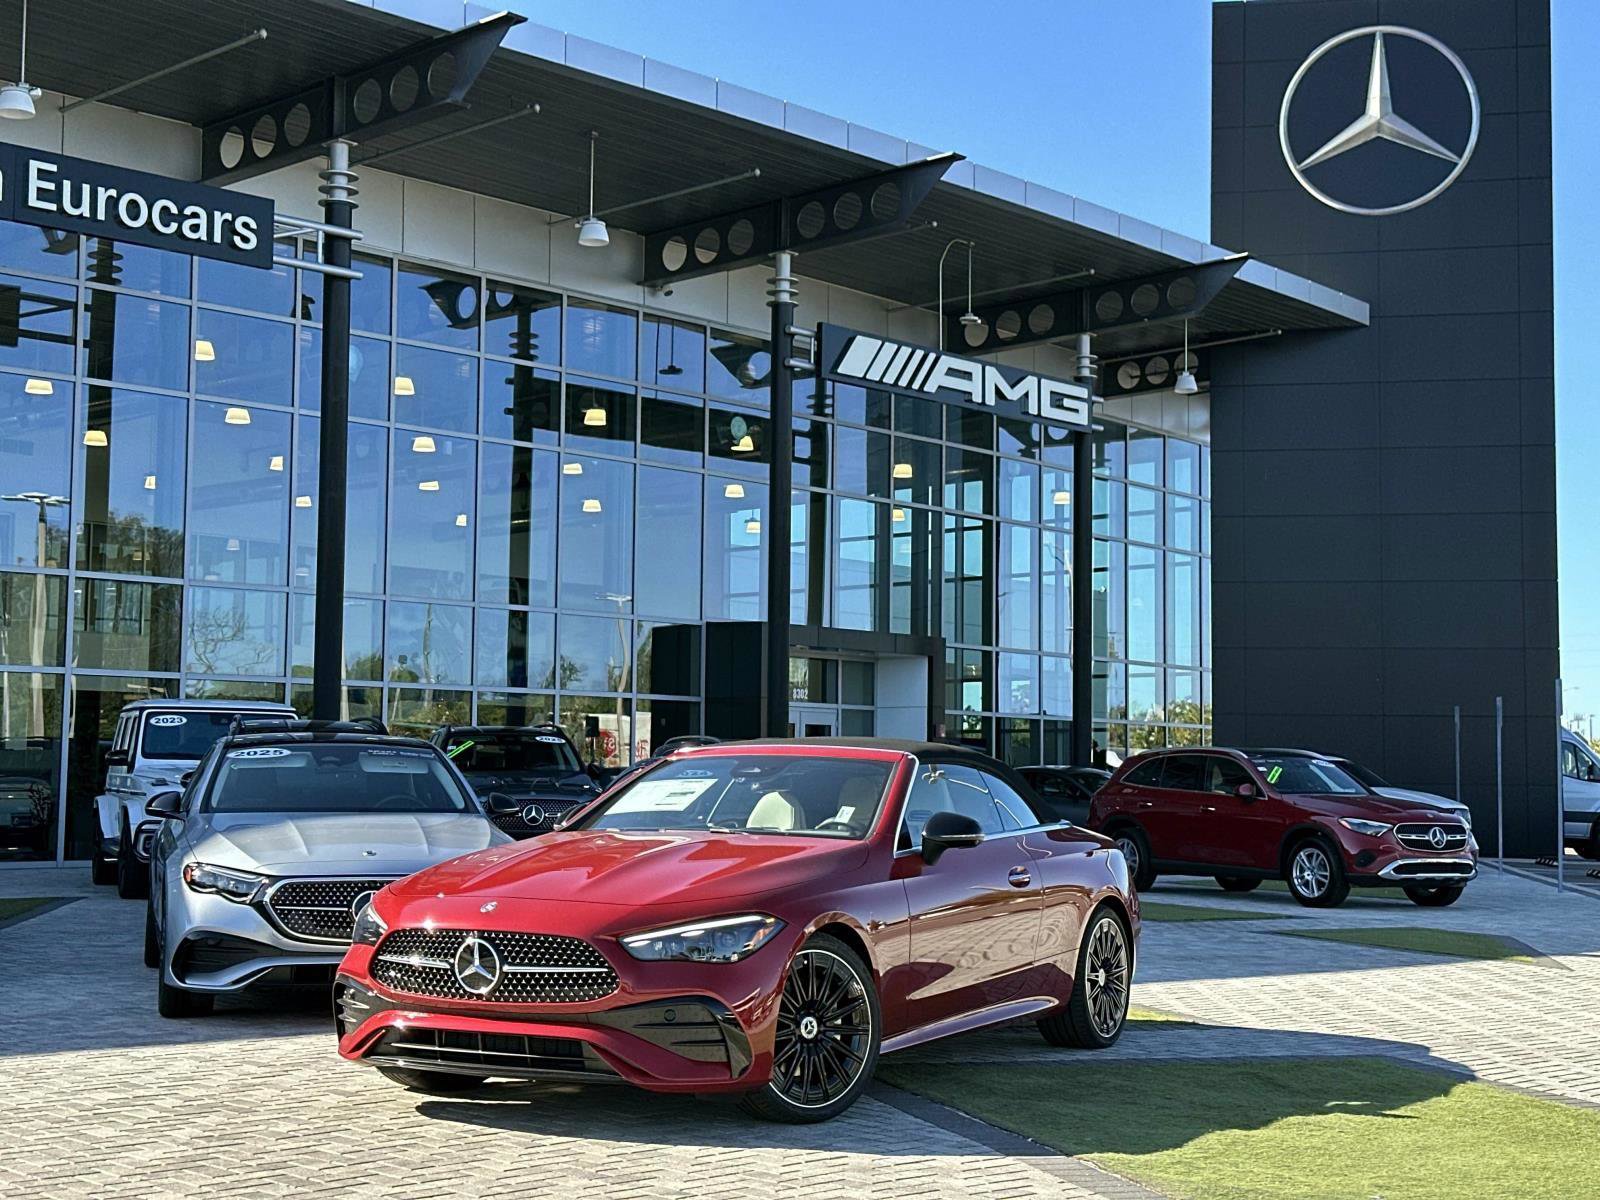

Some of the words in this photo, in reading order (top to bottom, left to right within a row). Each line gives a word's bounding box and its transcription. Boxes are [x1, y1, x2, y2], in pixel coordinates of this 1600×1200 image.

[28, 159, 258, 250] Eurocars
[923, 355, 1088, 426] AMG
[154, 716, 184, 724] 2023
[234, 749, 284, 757] 2025
